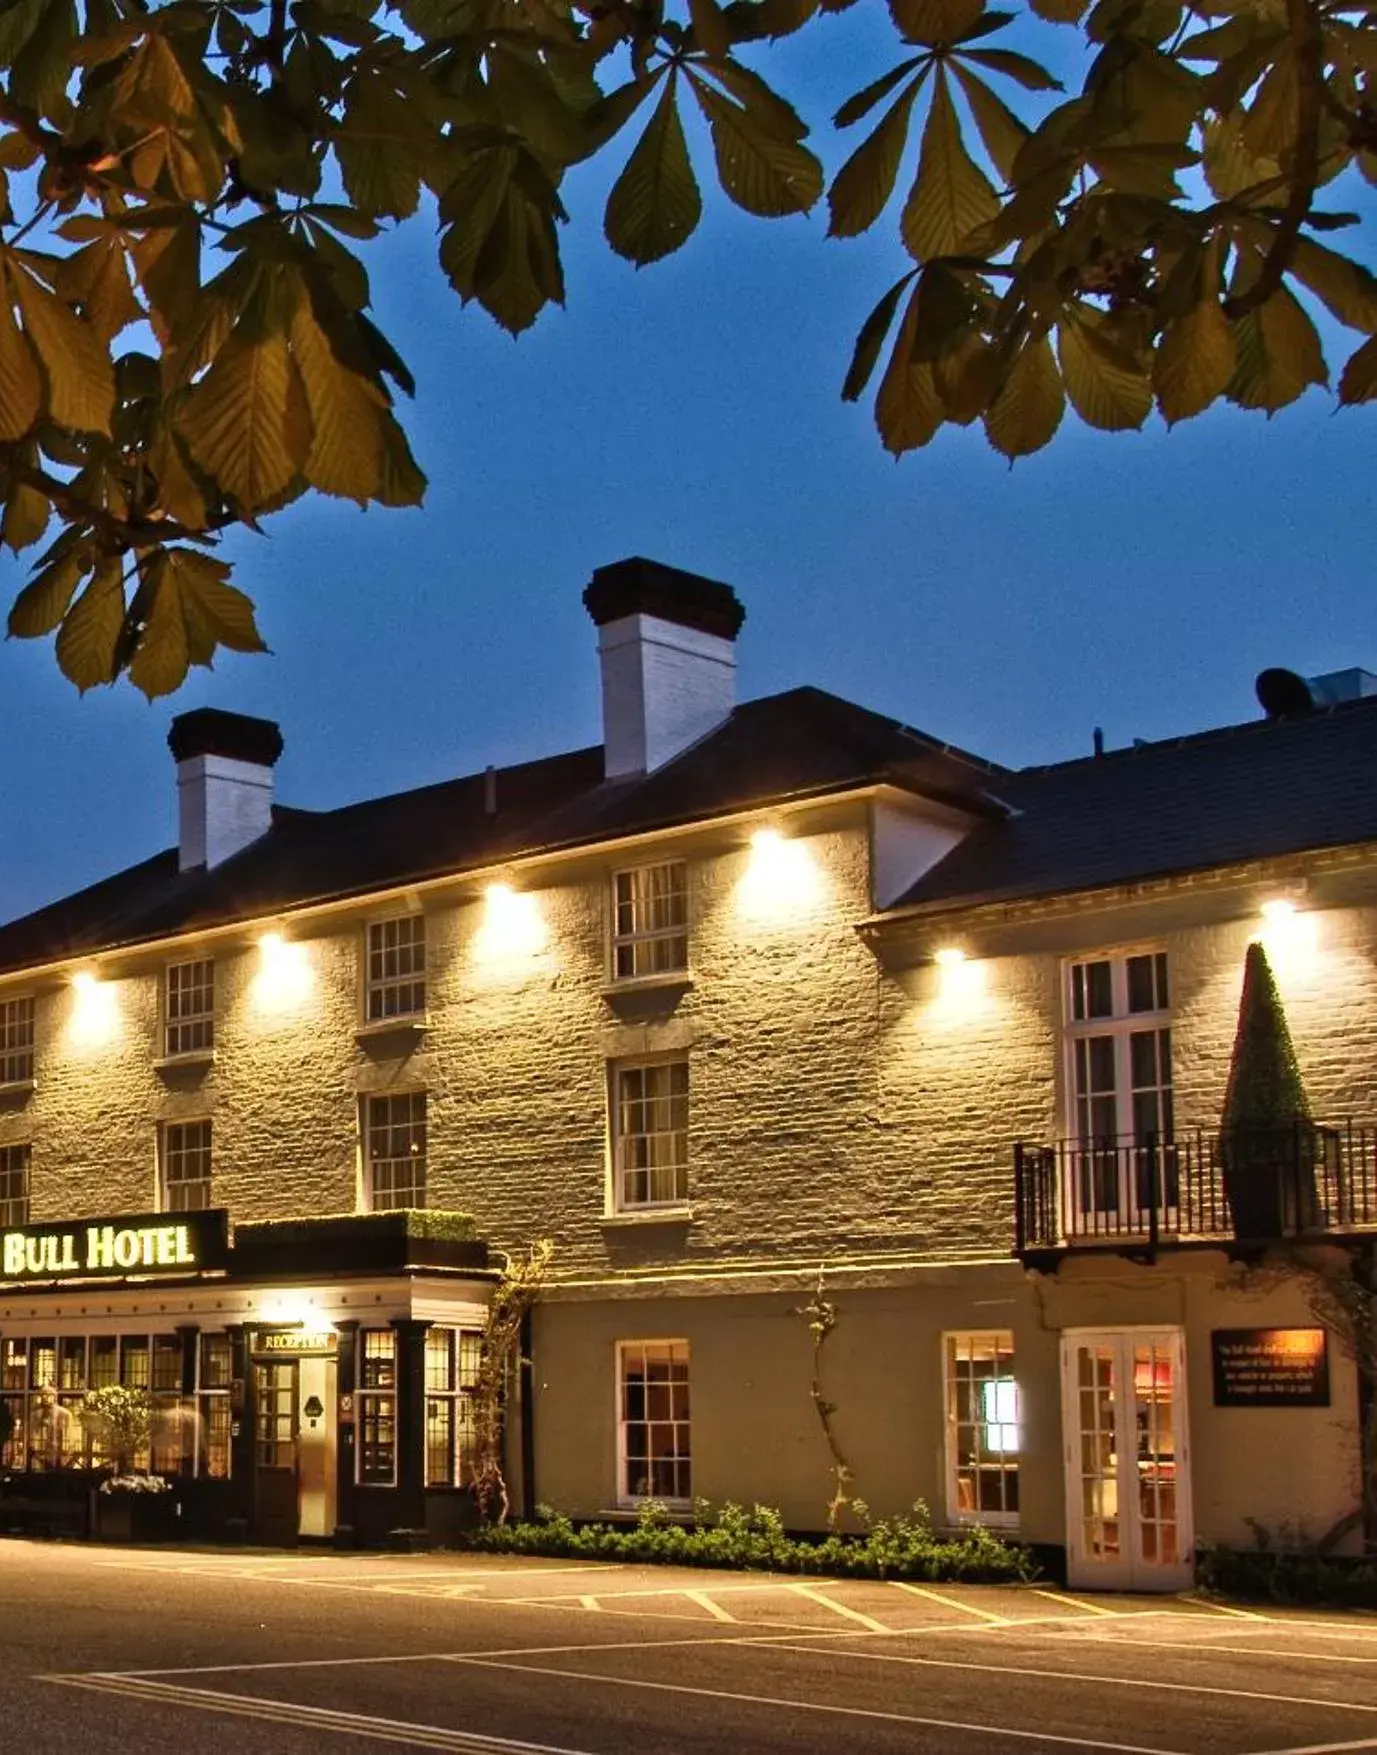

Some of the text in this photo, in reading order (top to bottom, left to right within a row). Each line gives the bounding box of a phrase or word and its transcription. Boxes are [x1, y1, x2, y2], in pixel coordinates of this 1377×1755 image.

[3, 1232, 79, 1274] BULL
[86, 1225, 195, 1269] HOTEL
[265, 1334, 328, 1349] RECEPTION
